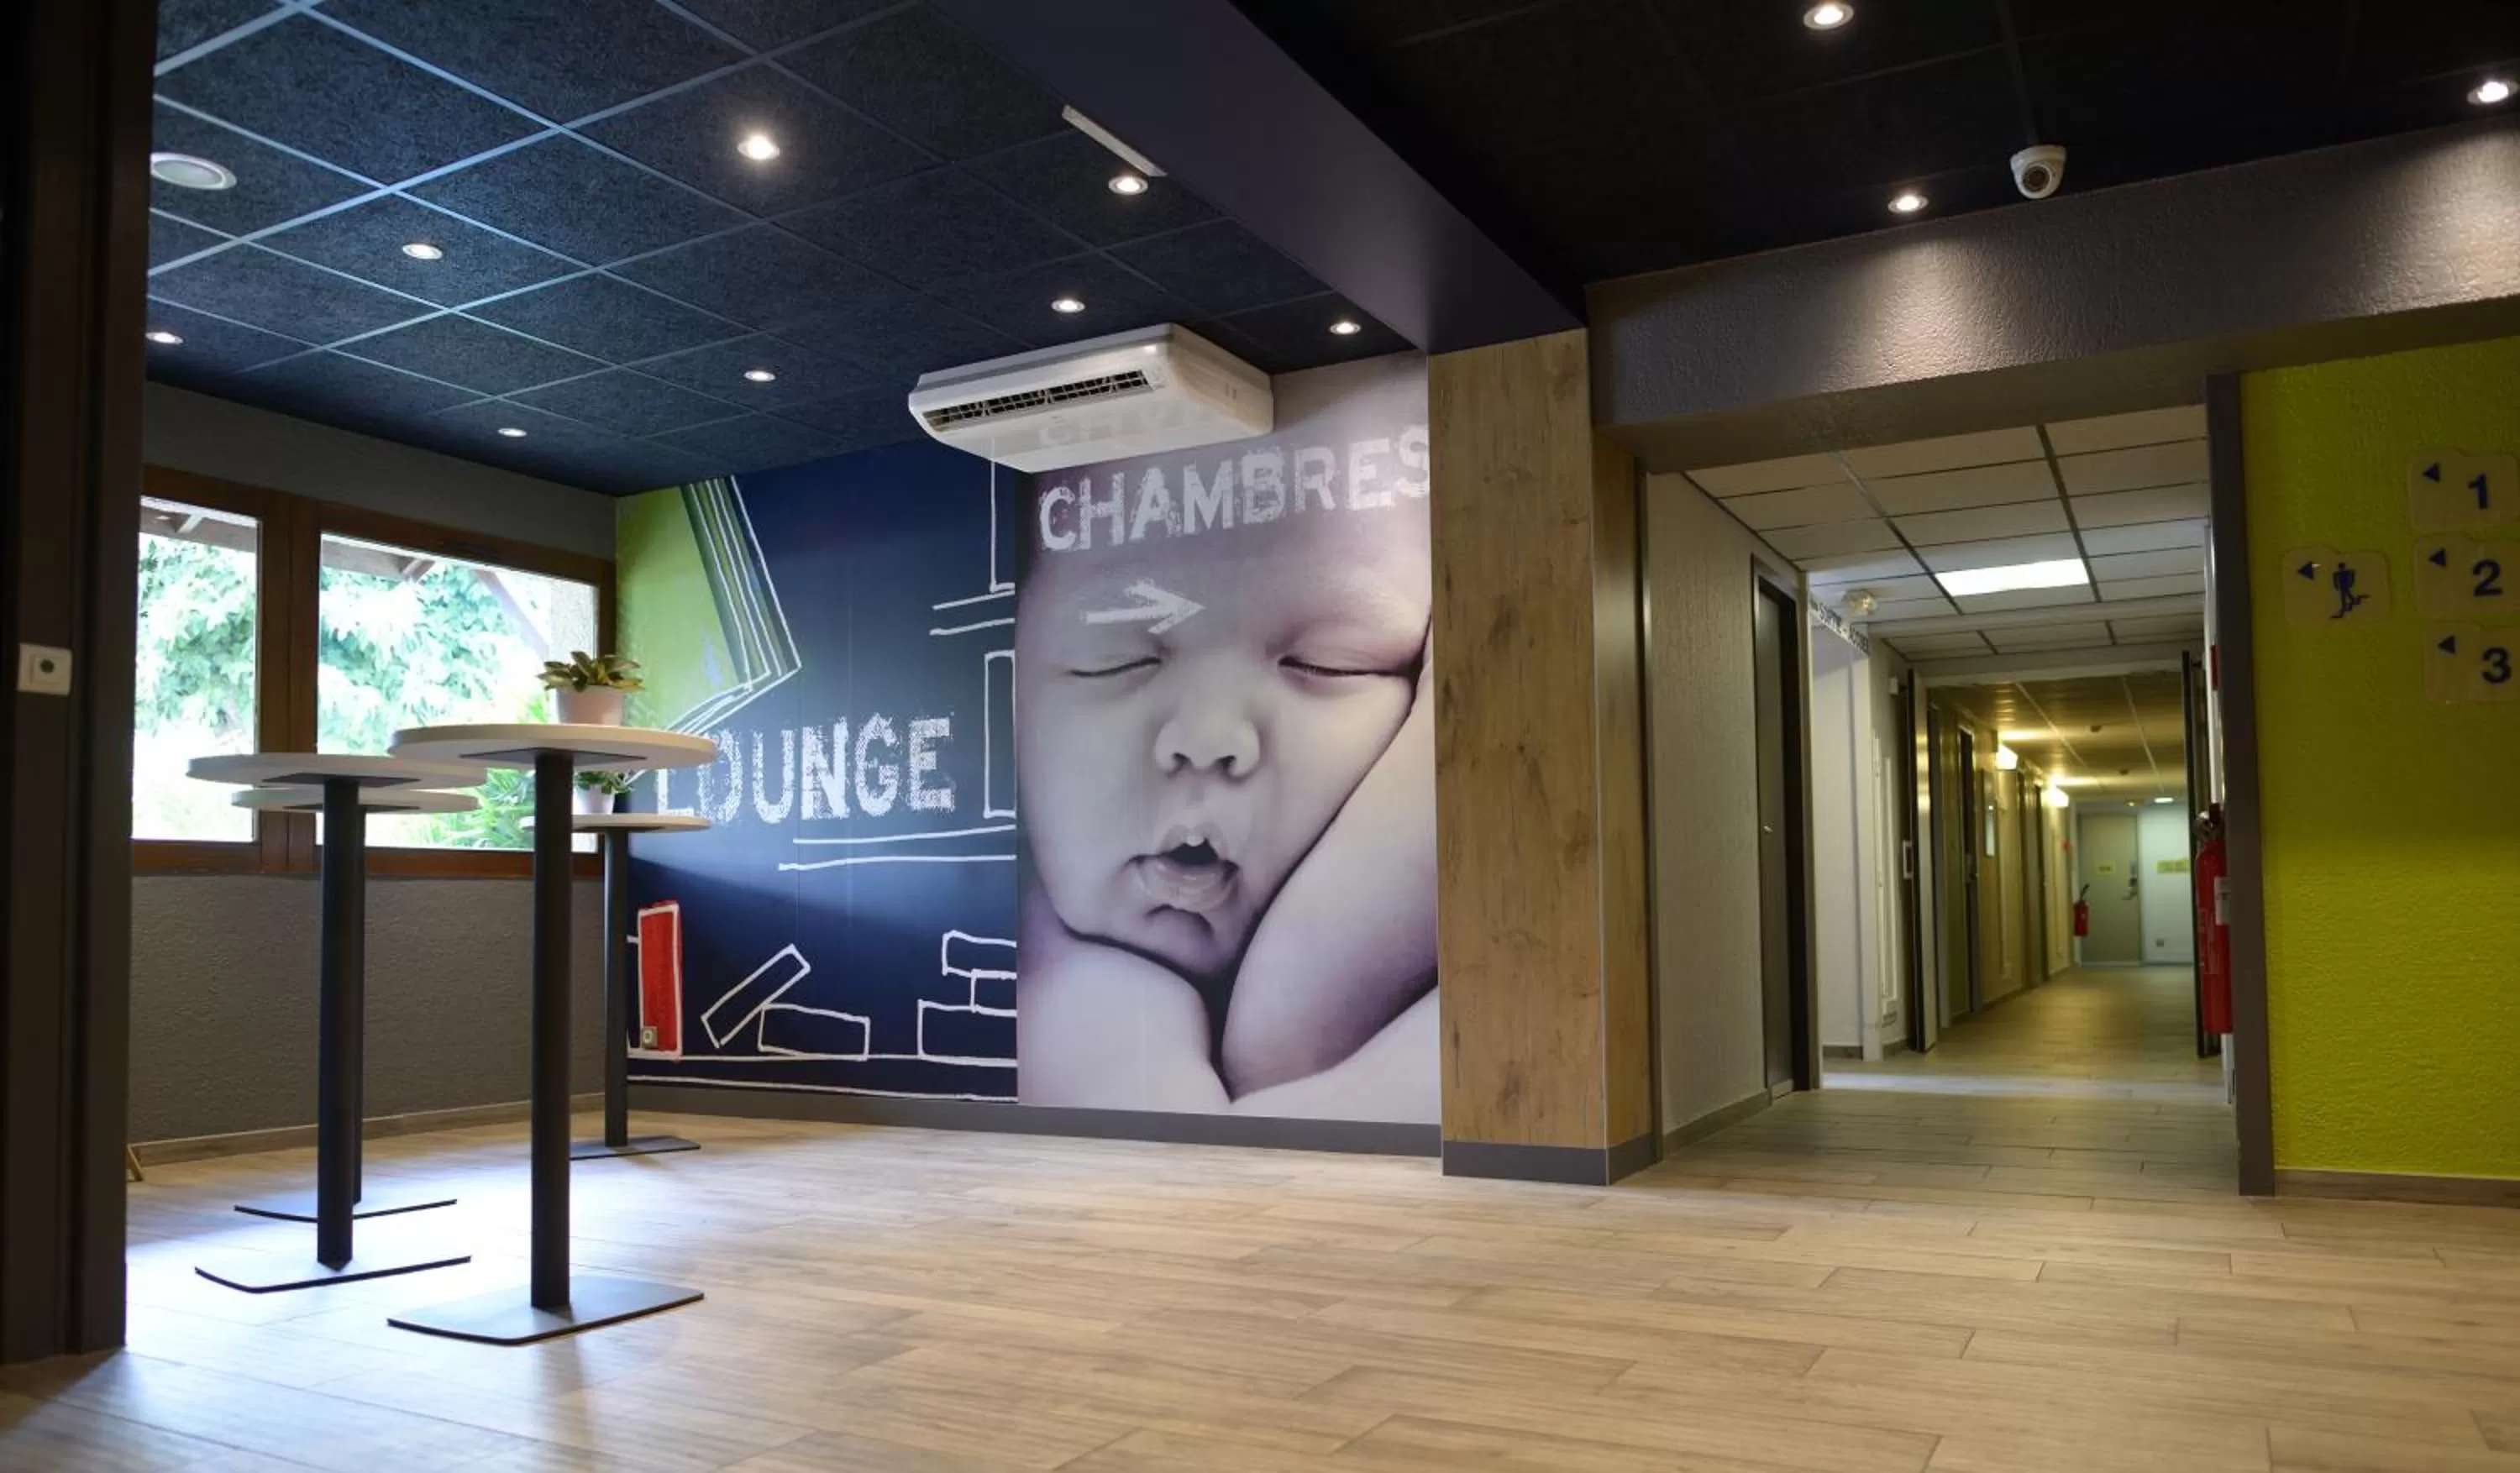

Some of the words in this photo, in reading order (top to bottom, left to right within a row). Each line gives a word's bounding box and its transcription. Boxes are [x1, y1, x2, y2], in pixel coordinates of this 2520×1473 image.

[1039, 424, 1430, 551] CHAMBRES
[2468, 473, 2488, 510] 1
[2472, 558, 2504, 597] 2
[2481, 646, 2512, 684] 3
[656, 713, 955, 824] LOUNGE
